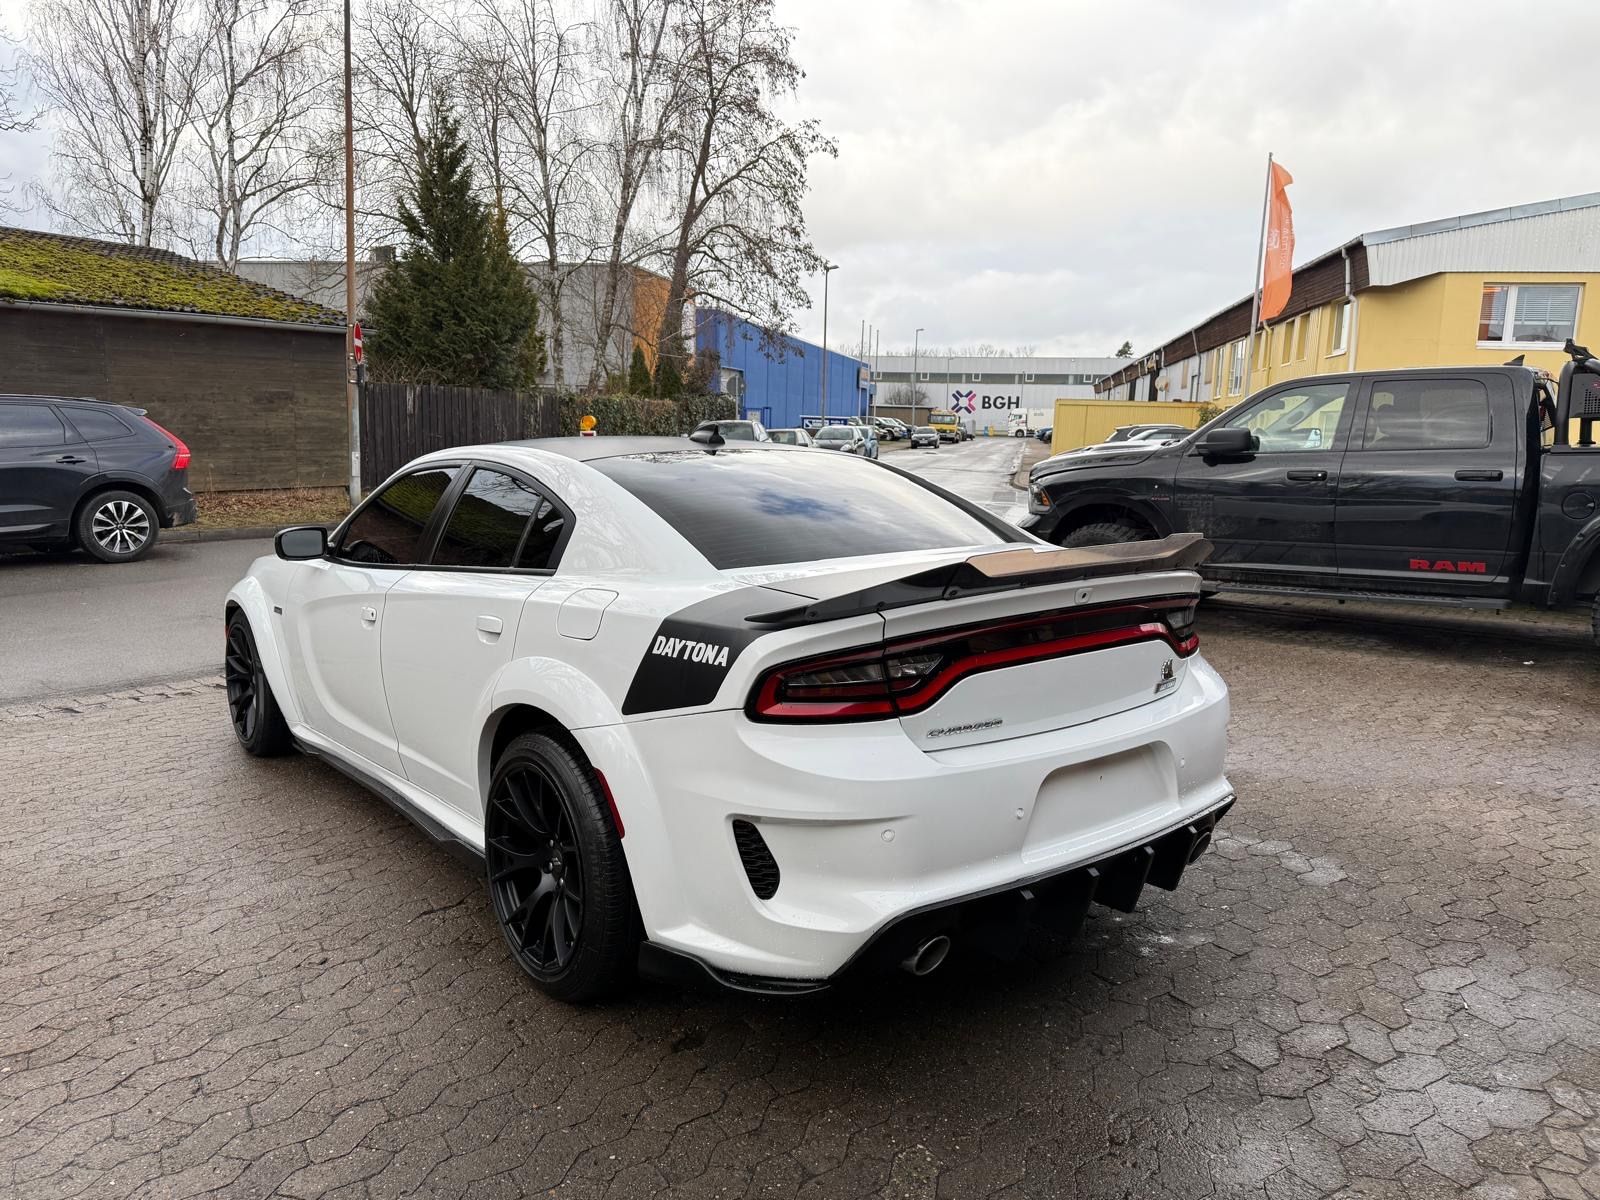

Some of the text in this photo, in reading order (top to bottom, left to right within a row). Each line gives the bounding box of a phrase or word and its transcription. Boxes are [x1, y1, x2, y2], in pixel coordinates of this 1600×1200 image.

[982, 395, 1020, 409] BGH
[1409, 558, 1486, 573] RAM
[652, 635, 730, 667] DAYTONA
